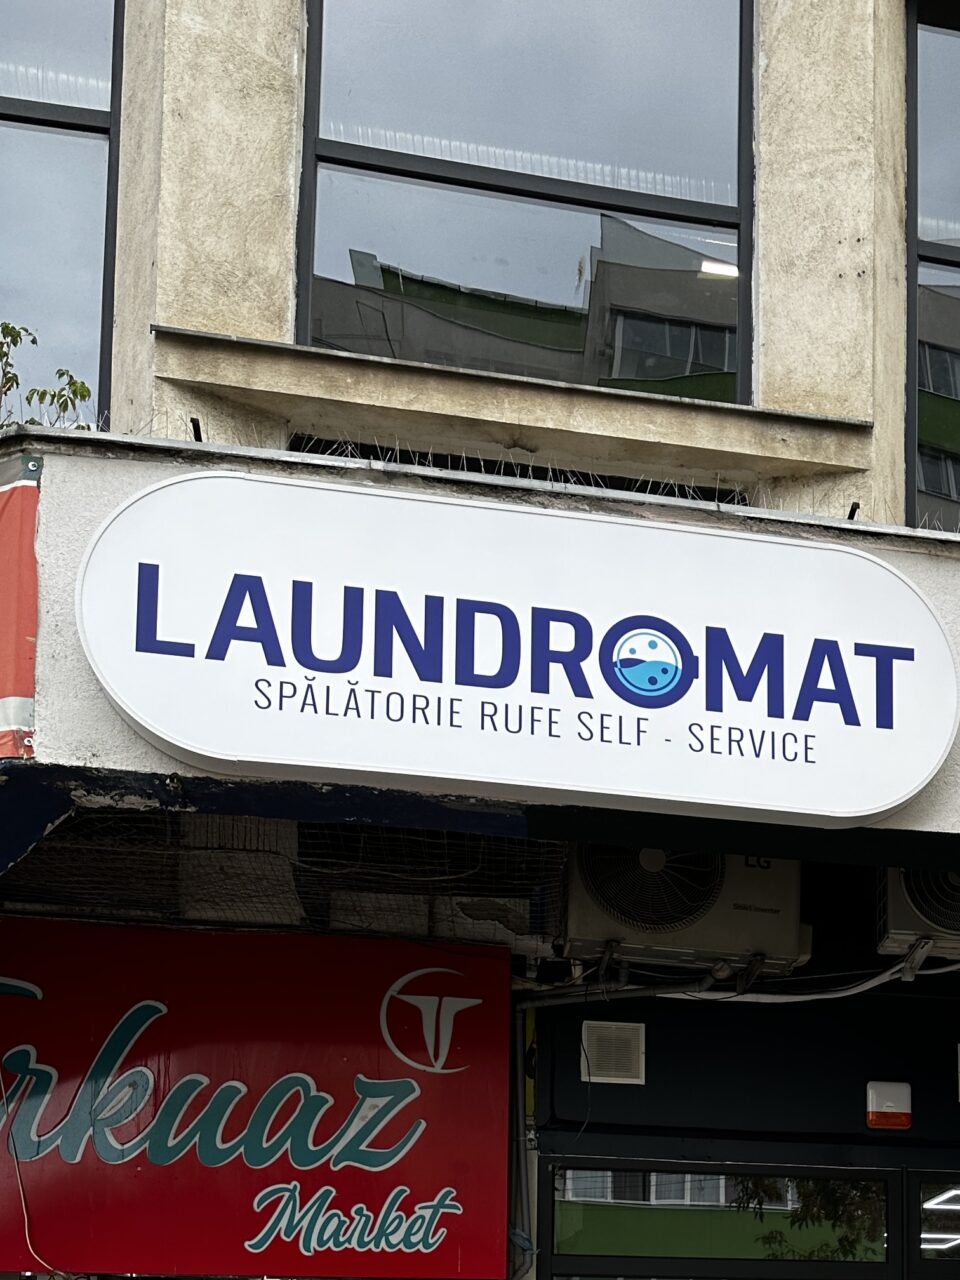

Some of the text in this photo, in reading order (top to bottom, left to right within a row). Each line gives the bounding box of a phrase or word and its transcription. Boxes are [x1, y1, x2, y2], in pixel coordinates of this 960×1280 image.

[134, 562, 915, 731] LAUNDROMAT
[254, 675, 464, 729] SPĂLĂTORIE
[479, 701, 562, 739] RUFE
[576, 711, 649, 747] SELF
[687, 721, 818, 766] SERVICE
[0, 977, 426, 1172] rkuaz
[244, 1181, 463, 1256] Market
